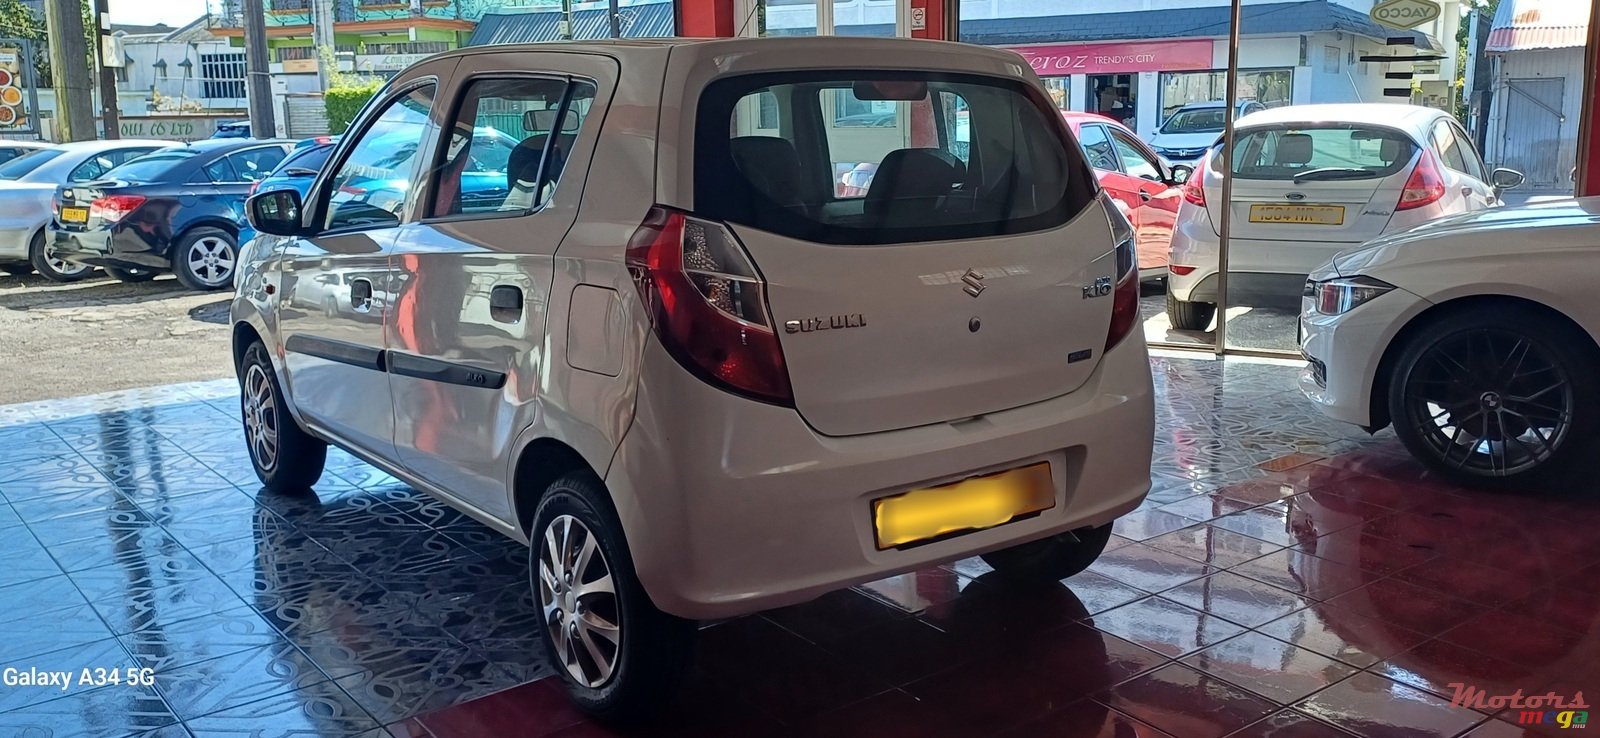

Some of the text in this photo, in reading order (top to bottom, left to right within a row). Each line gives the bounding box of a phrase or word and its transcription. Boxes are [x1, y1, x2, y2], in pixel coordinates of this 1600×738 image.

[1021, 52, 1155, 70] eroz TRENDY'S CITY
[150, 122, 166, 136] CO
[170, 122, 193, 136] LTD
[784, 313, 867, 334] SUZUKI
